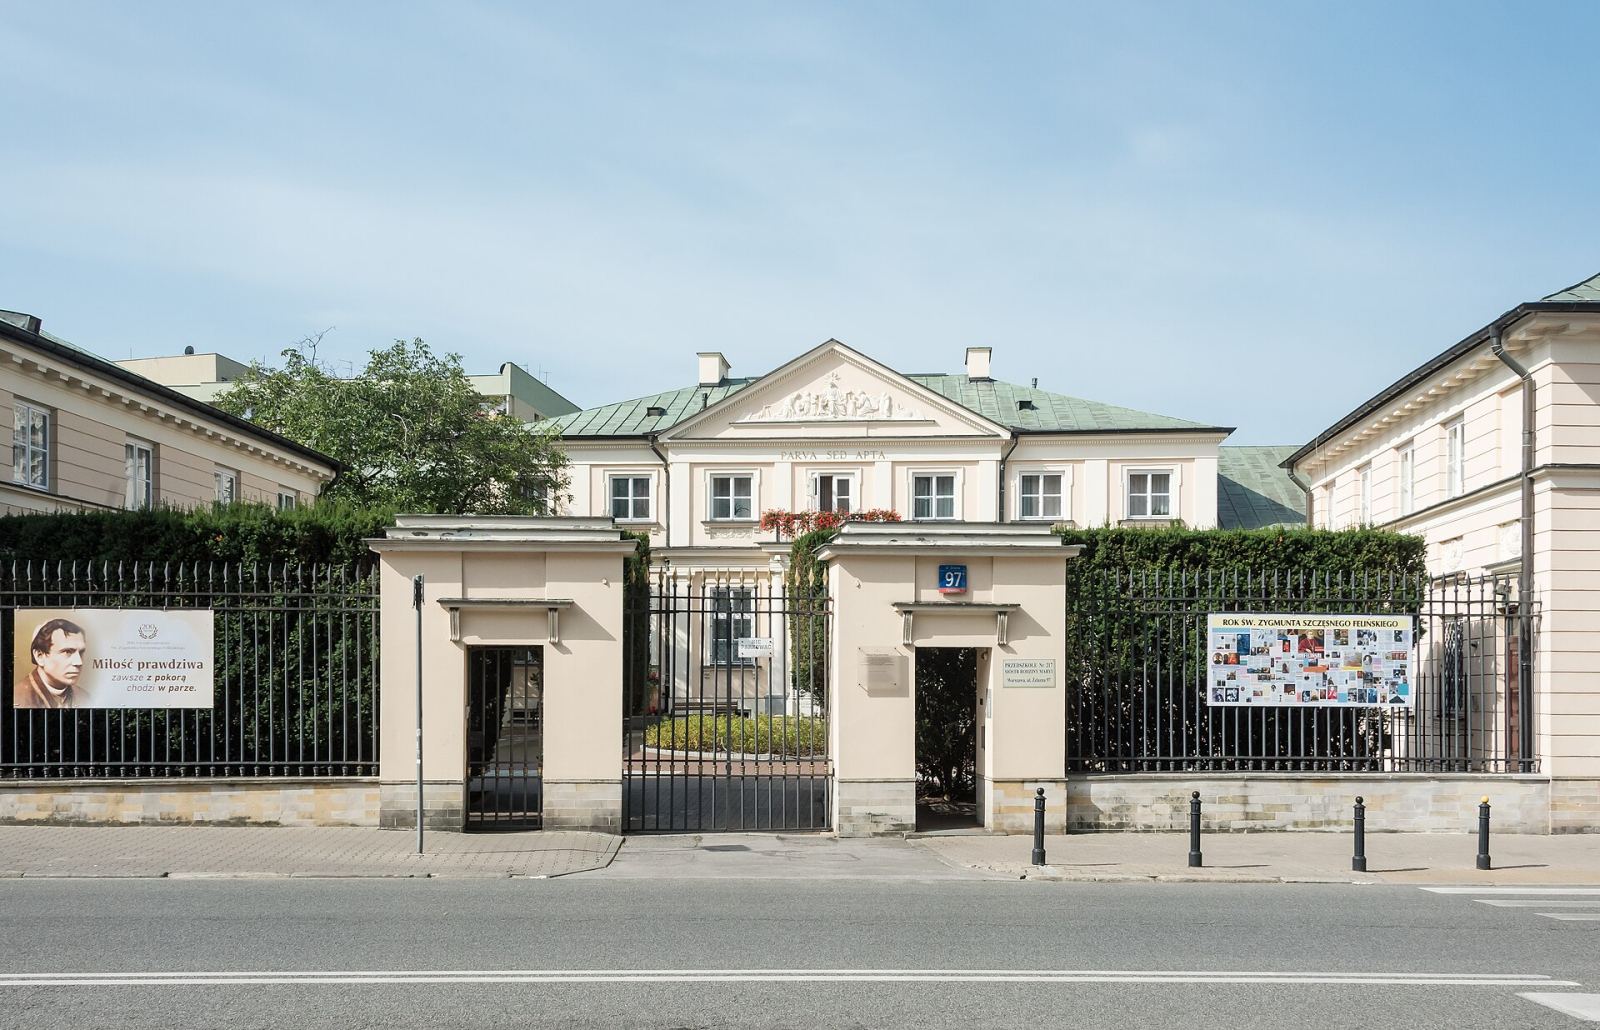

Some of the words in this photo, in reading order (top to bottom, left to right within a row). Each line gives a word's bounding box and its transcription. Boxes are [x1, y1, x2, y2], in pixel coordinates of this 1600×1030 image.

[781, 450, 817, 460] PARVA
[826, 450, 848, 460] SED
[855, 450, 886, 460] APTA
[945, 571, 962, 587] 97
[1241, 617, 1256, 626] ŚW.
[1258, 619, 1301, 627] ZYGMUNTA
[1302, 619, 1351, 628] SZCZĘSNEGO
[1353, 618, 1399, 627] FELIŃSKIEGO
[92, 658, 133, 669] Miłość
[138, 658, 204, 671] prawdziwa
[154, 673, 187, 683] pokorą
[127, 684, 156, 692] chodzi
[168, 685, 197, 693] parze.
